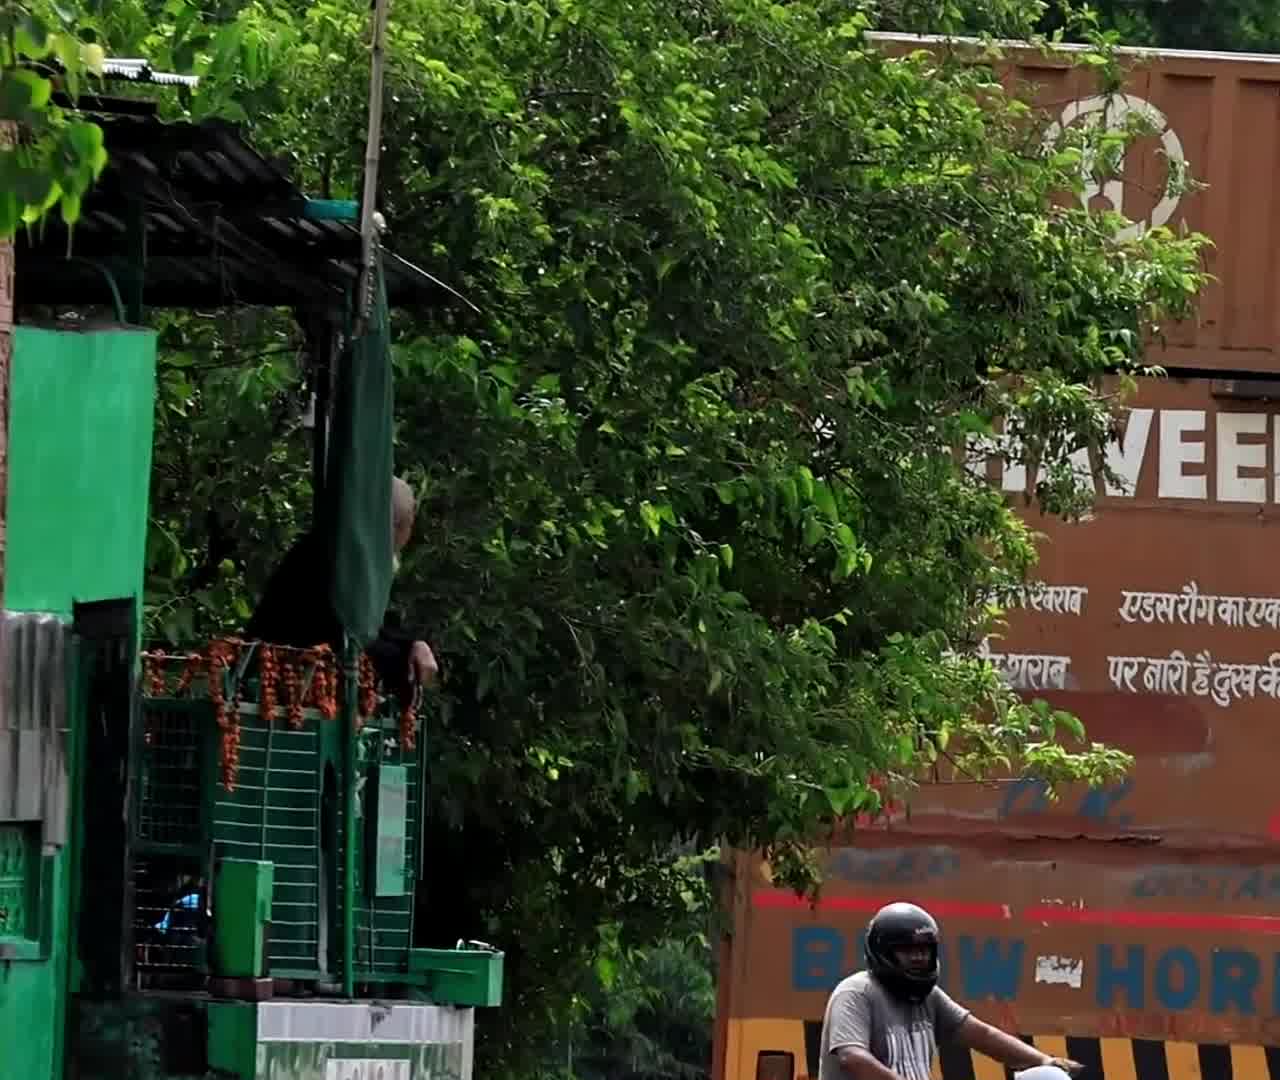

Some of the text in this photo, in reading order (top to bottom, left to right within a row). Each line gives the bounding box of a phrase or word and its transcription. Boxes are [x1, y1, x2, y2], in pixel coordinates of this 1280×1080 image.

[1217, 596, 1247, 629] का
[1107, 656, 1146, 693] पर
[1144, 650, 1191, 695] नारी
